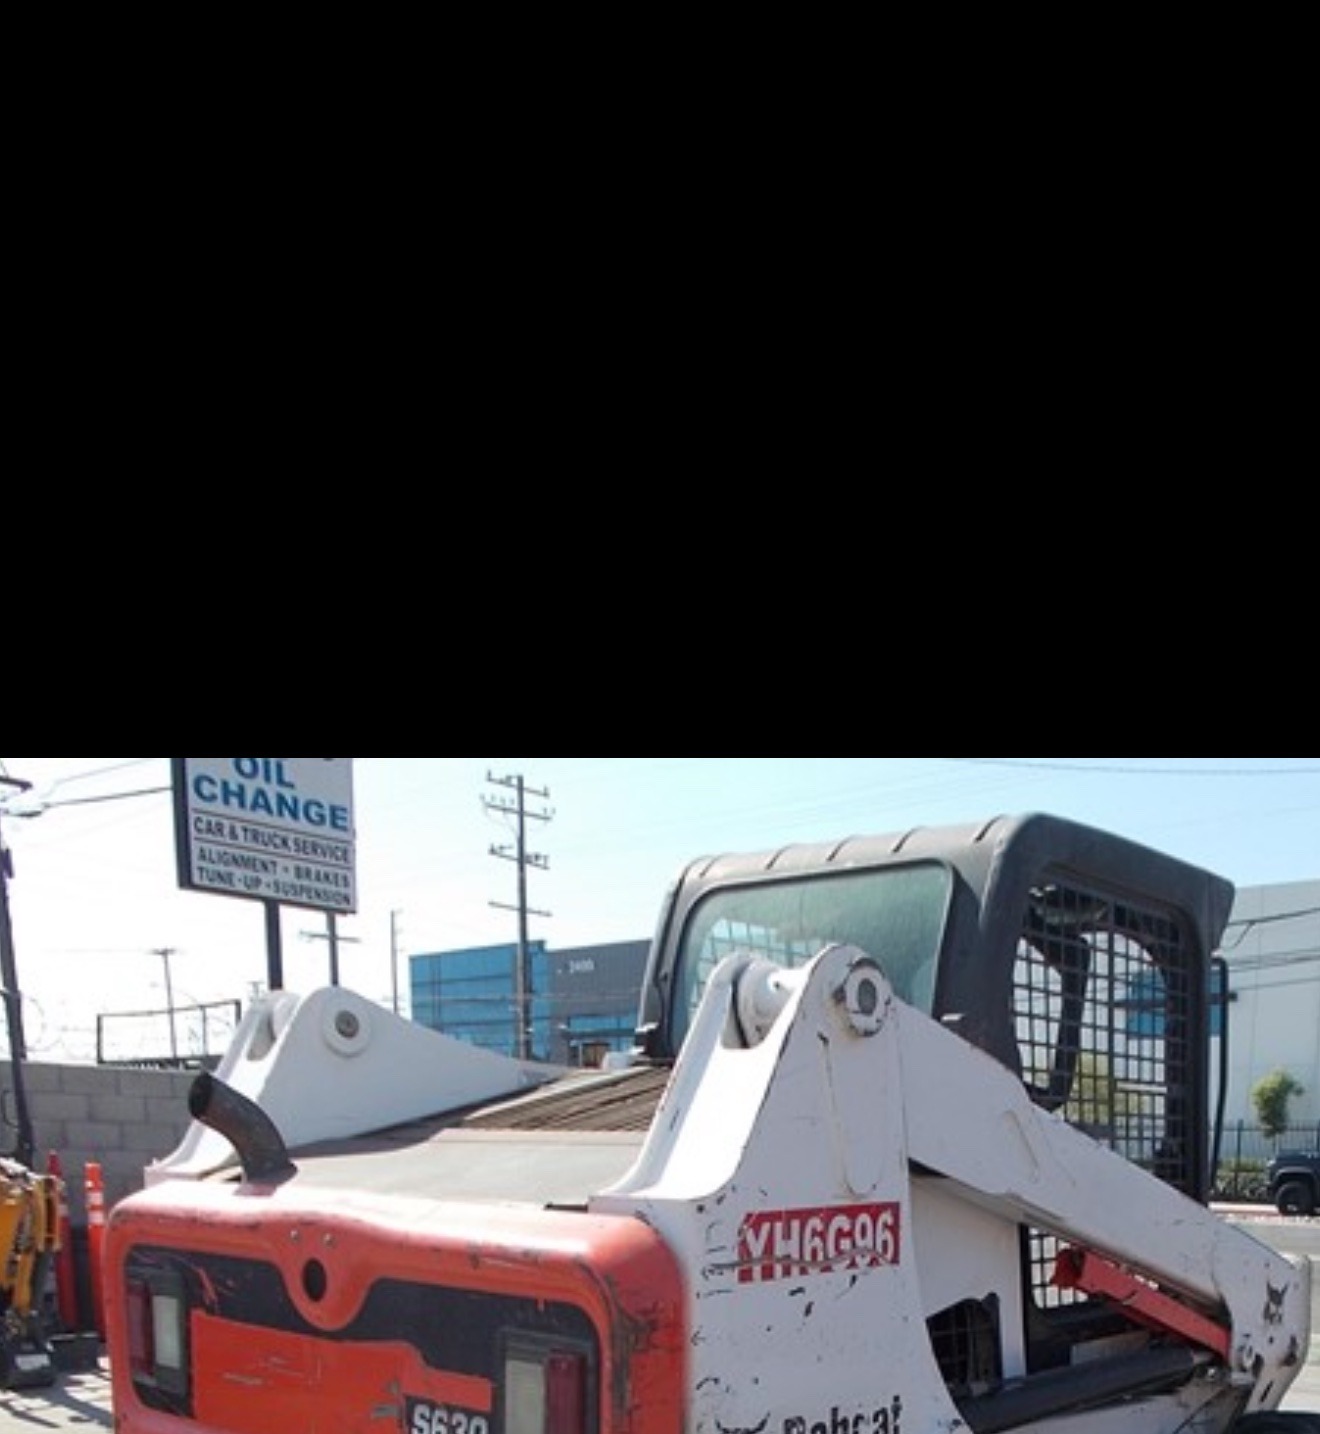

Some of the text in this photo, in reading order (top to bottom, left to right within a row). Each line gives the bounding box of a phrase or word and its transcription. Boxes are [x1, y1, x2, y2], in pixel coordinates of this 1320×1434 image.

[233, 758, 295, 789] OIL
[193, 774, 348, 832] CHANGE
[194, 816, 348, 864] CAR & TRUCK SERVICE
[198, 846, 349, 888] ALIGNMENT BRAKES
[273, 880, 350, 906] SUSPENSION
